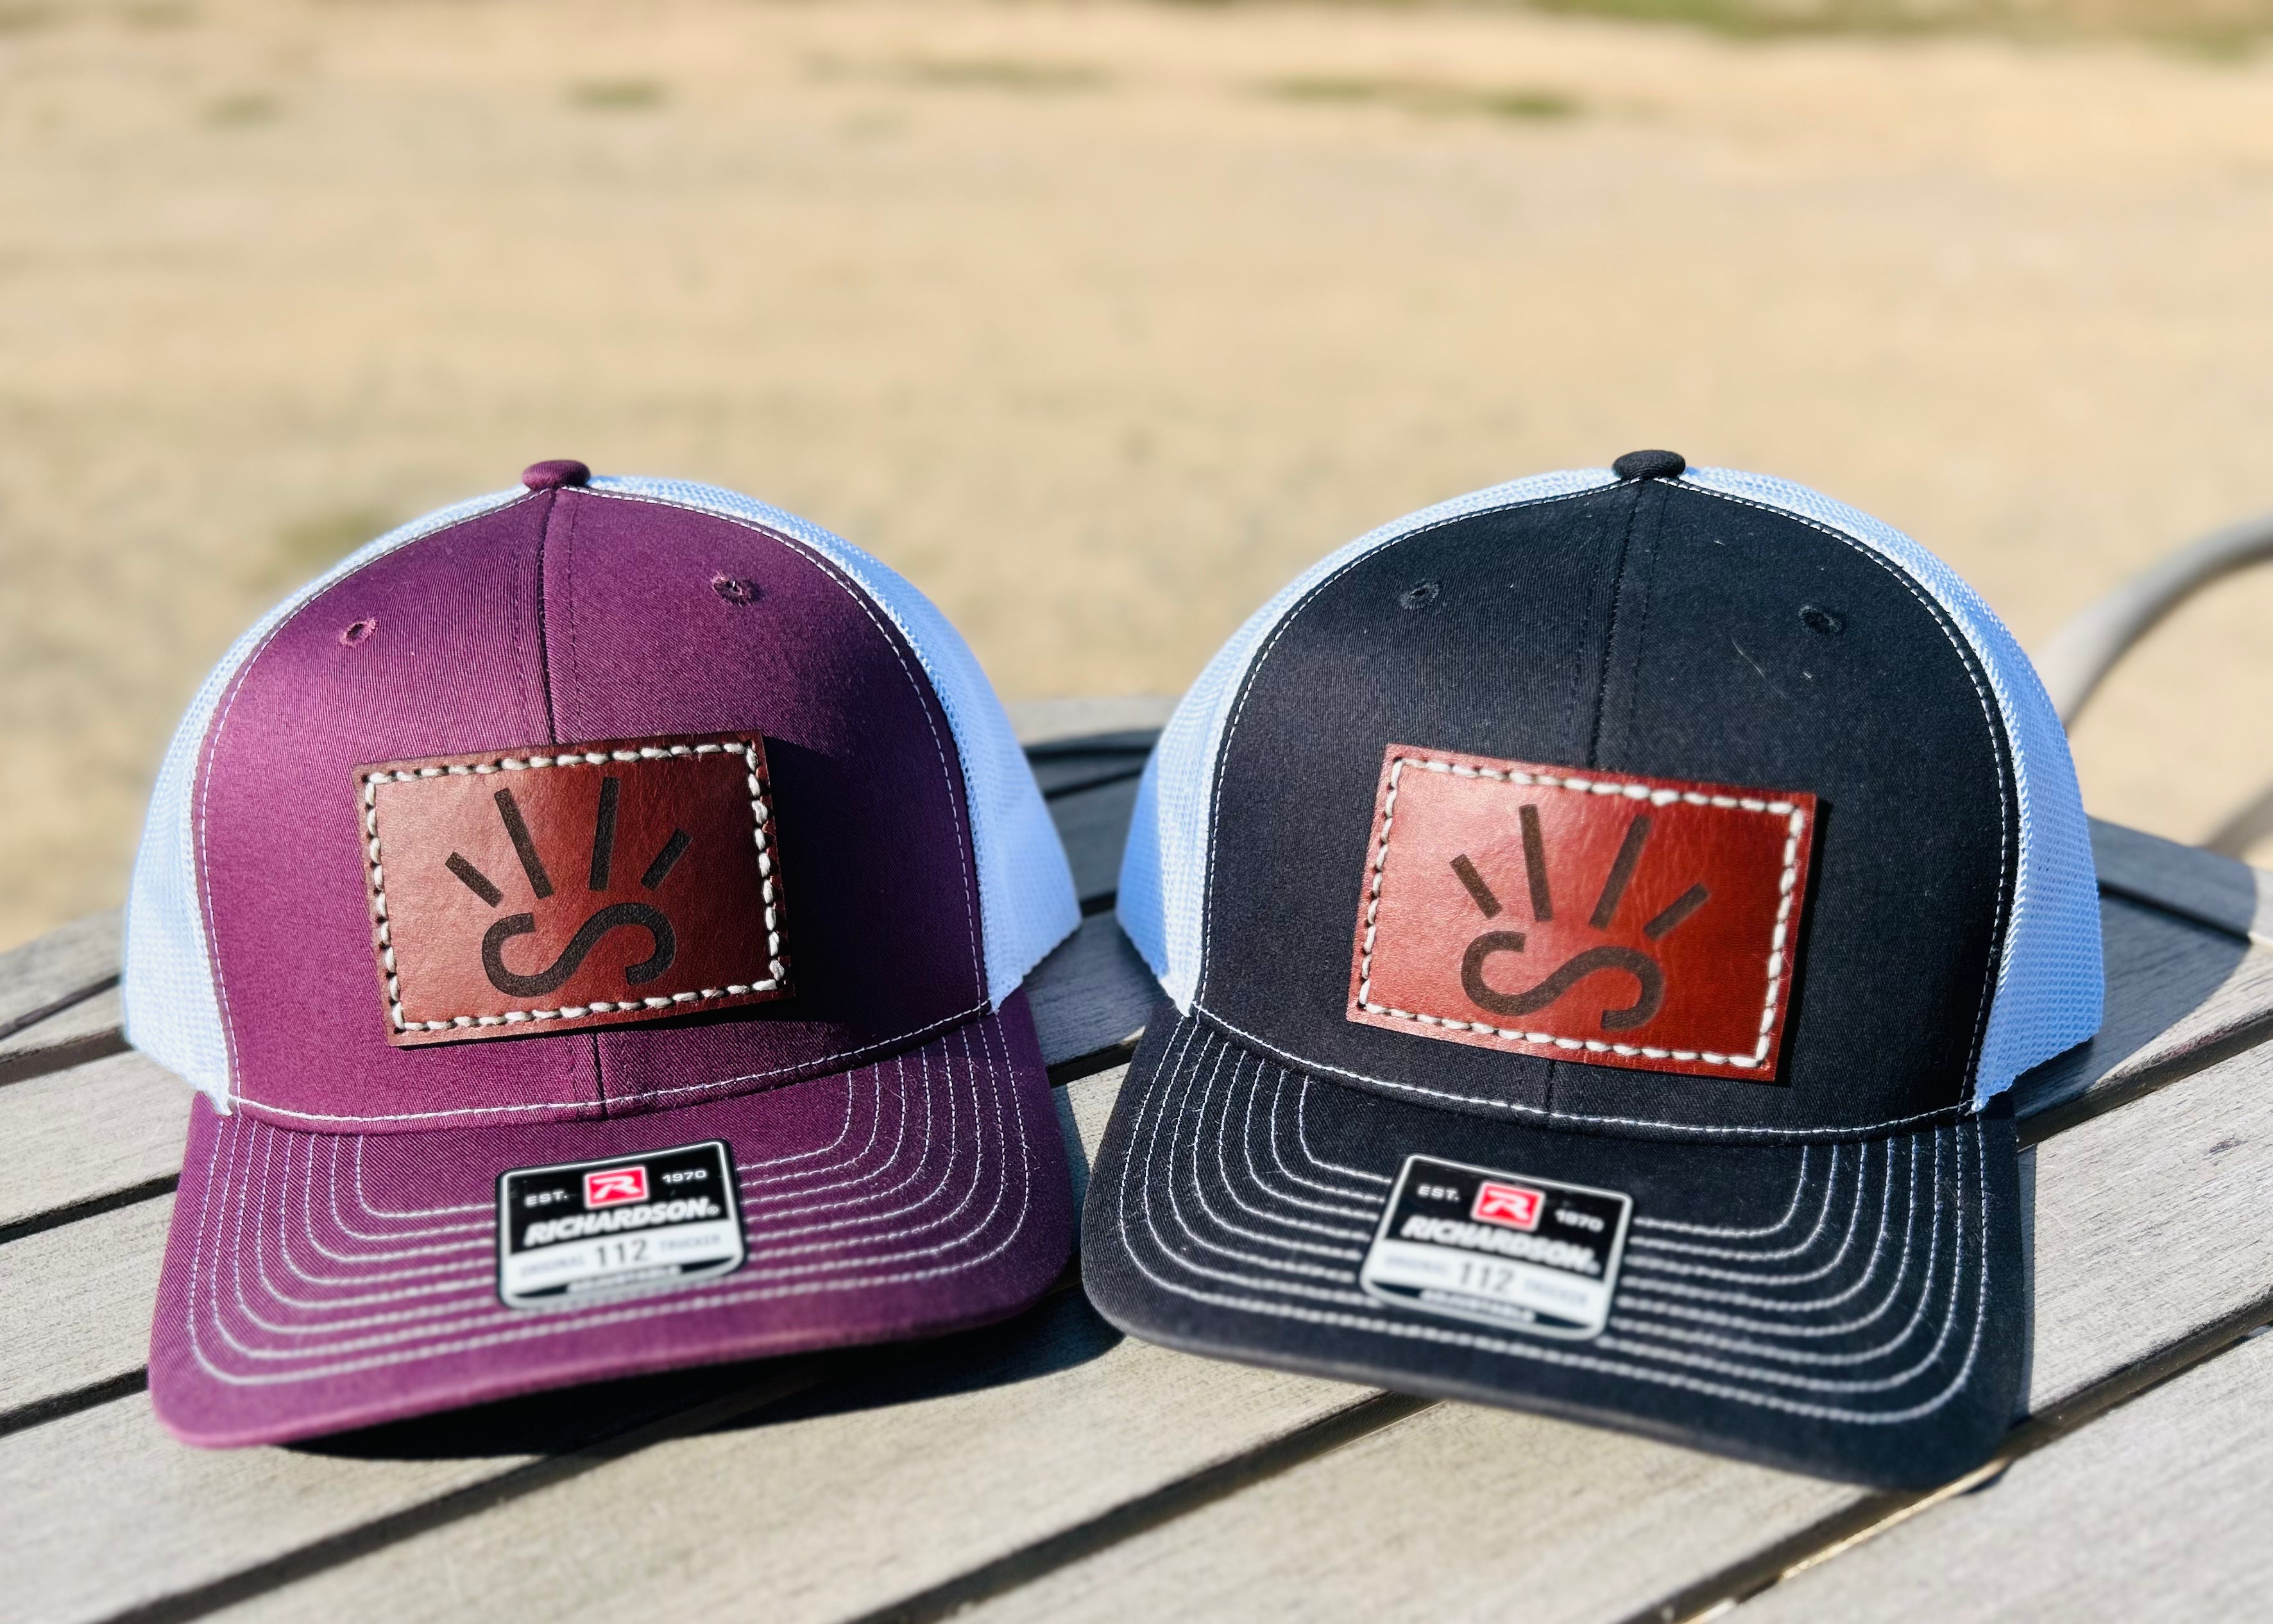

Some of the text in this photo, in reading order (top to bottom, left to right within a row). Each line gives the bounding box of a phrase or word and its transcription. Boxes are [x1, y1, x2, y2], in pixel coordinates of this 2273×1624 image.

[525, 1190, 568, 1208] EST.
[661, 1170, 707, 1183] 1970
[1417, 1184, 1460, 1202] EST.
[1554, 1208, 1605, 1233] 1970
[596, 1238, 649, 1268] 112
[1459, 1261, 1515, 1294] 112
